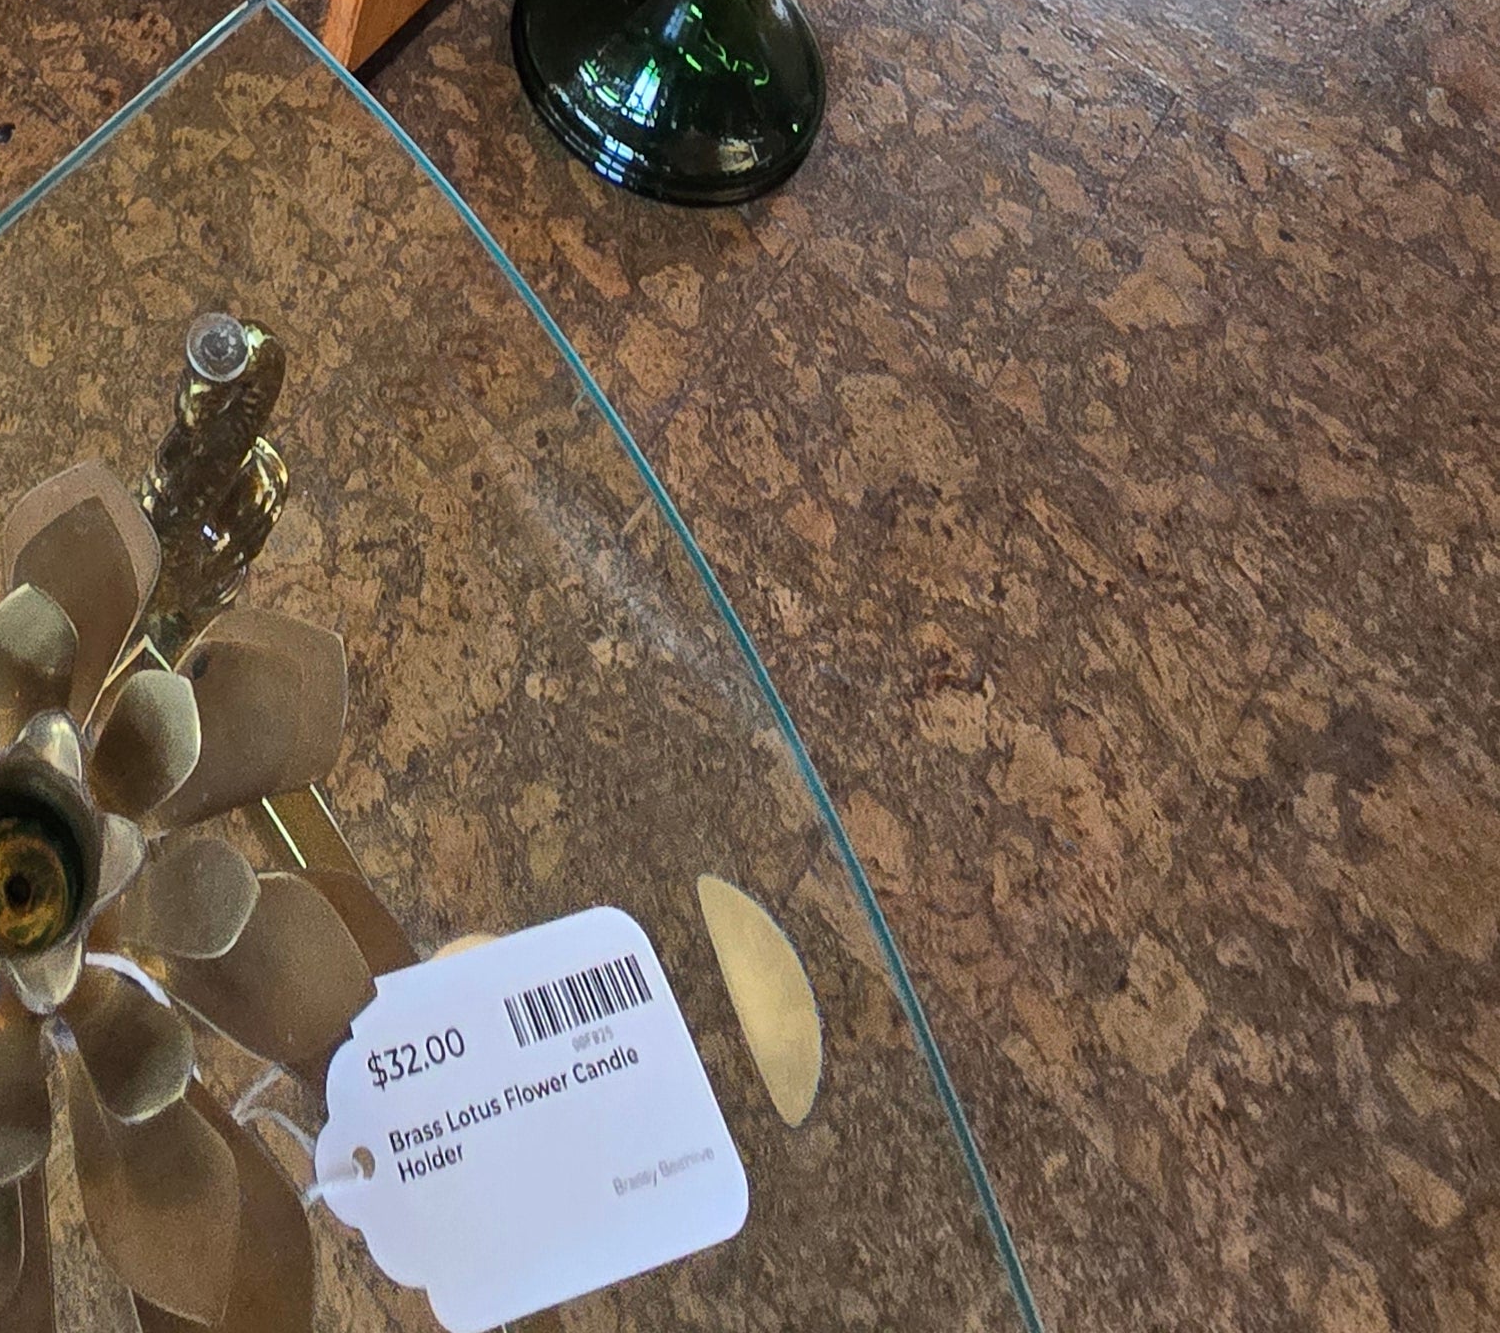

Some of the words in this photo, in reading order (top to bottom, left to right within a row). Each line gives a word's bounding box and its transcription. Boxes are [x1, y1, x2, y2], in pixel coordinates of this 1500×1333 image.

[367, 1027, 465, 1092] $32.00
[388, 1119, 444, 1154] Brass
[445, 1097, 502, 1132] Lotus
[503, 1072, 569, 1110] Flower
[572, 1046, 640, 1084] Candle
[397, 1143, 464, 1184] Holder
